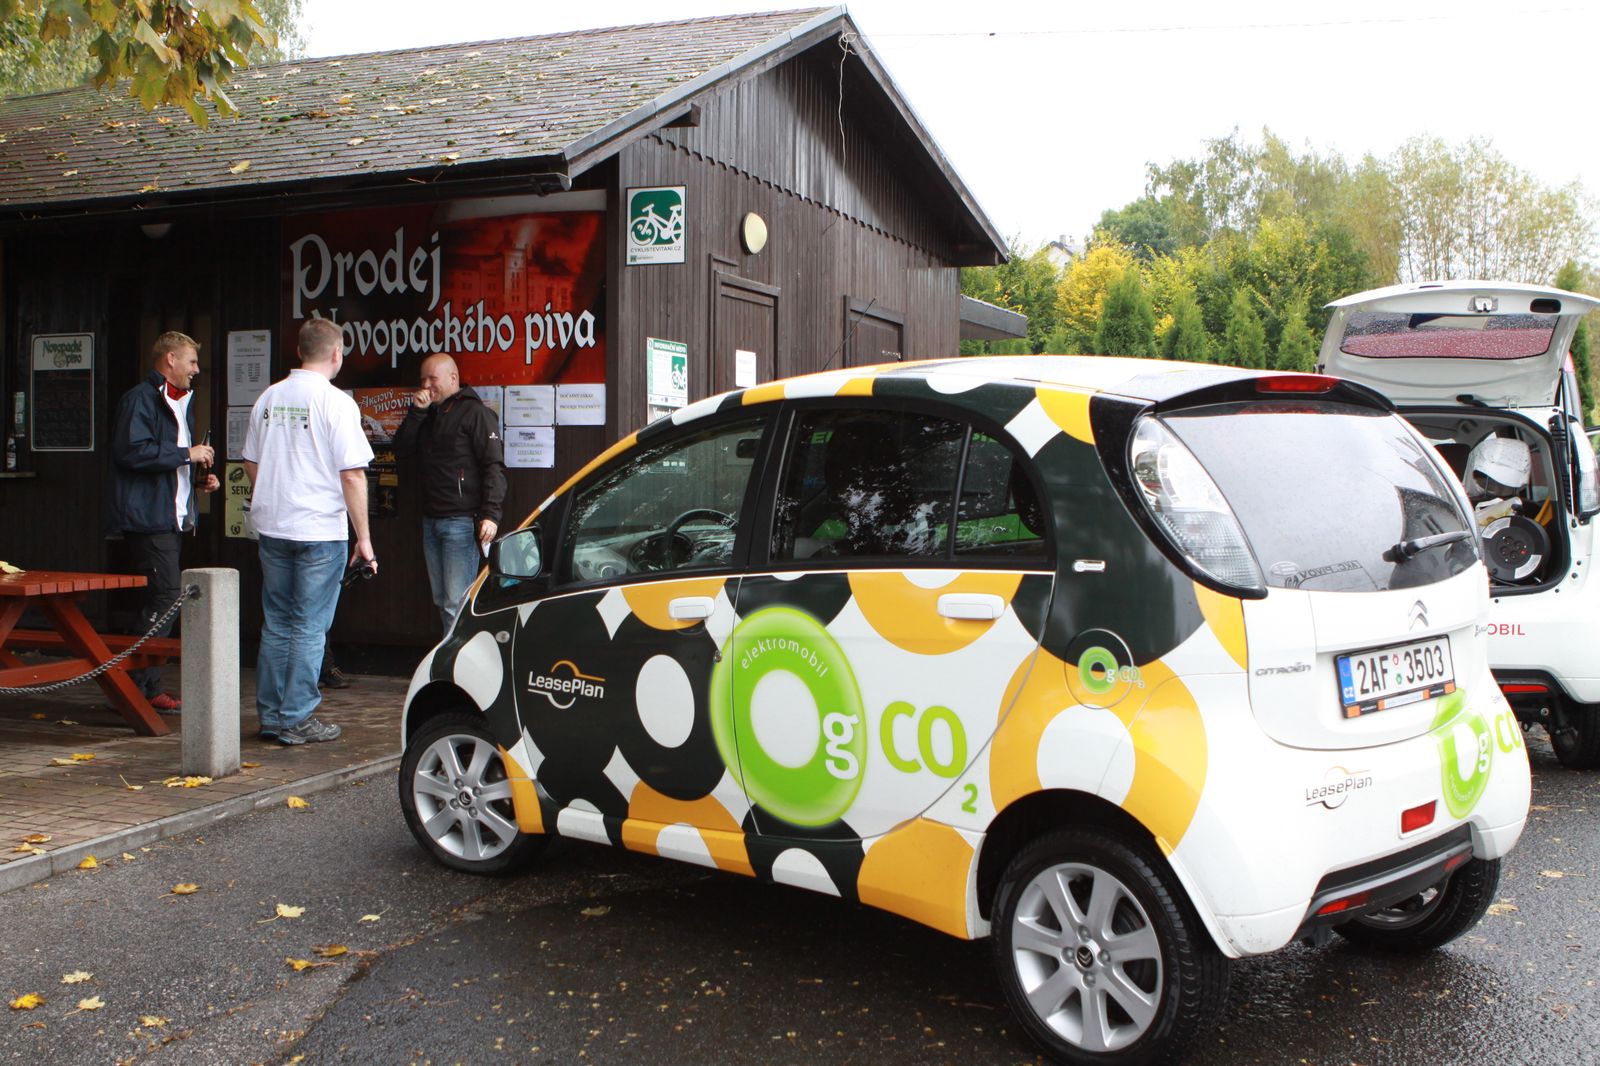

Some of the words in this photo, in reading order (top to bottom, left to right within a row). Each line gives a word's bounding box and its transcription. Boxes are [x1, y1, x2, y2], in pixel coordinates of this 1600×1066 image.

[289, 226, 441, 319] Prodej
[524, 302, 596, 364] piva
[1487, 623, 1526, 636] OBIL
[741, 638, 828, 678] elektromobil
[1356, 655, 1389, 695] 2AF
[1403, 645, 1445, 685] 3503
[528, 670, 605, 699] LeasePlan
[1305, 776, 1372, 801] LeasePlan
